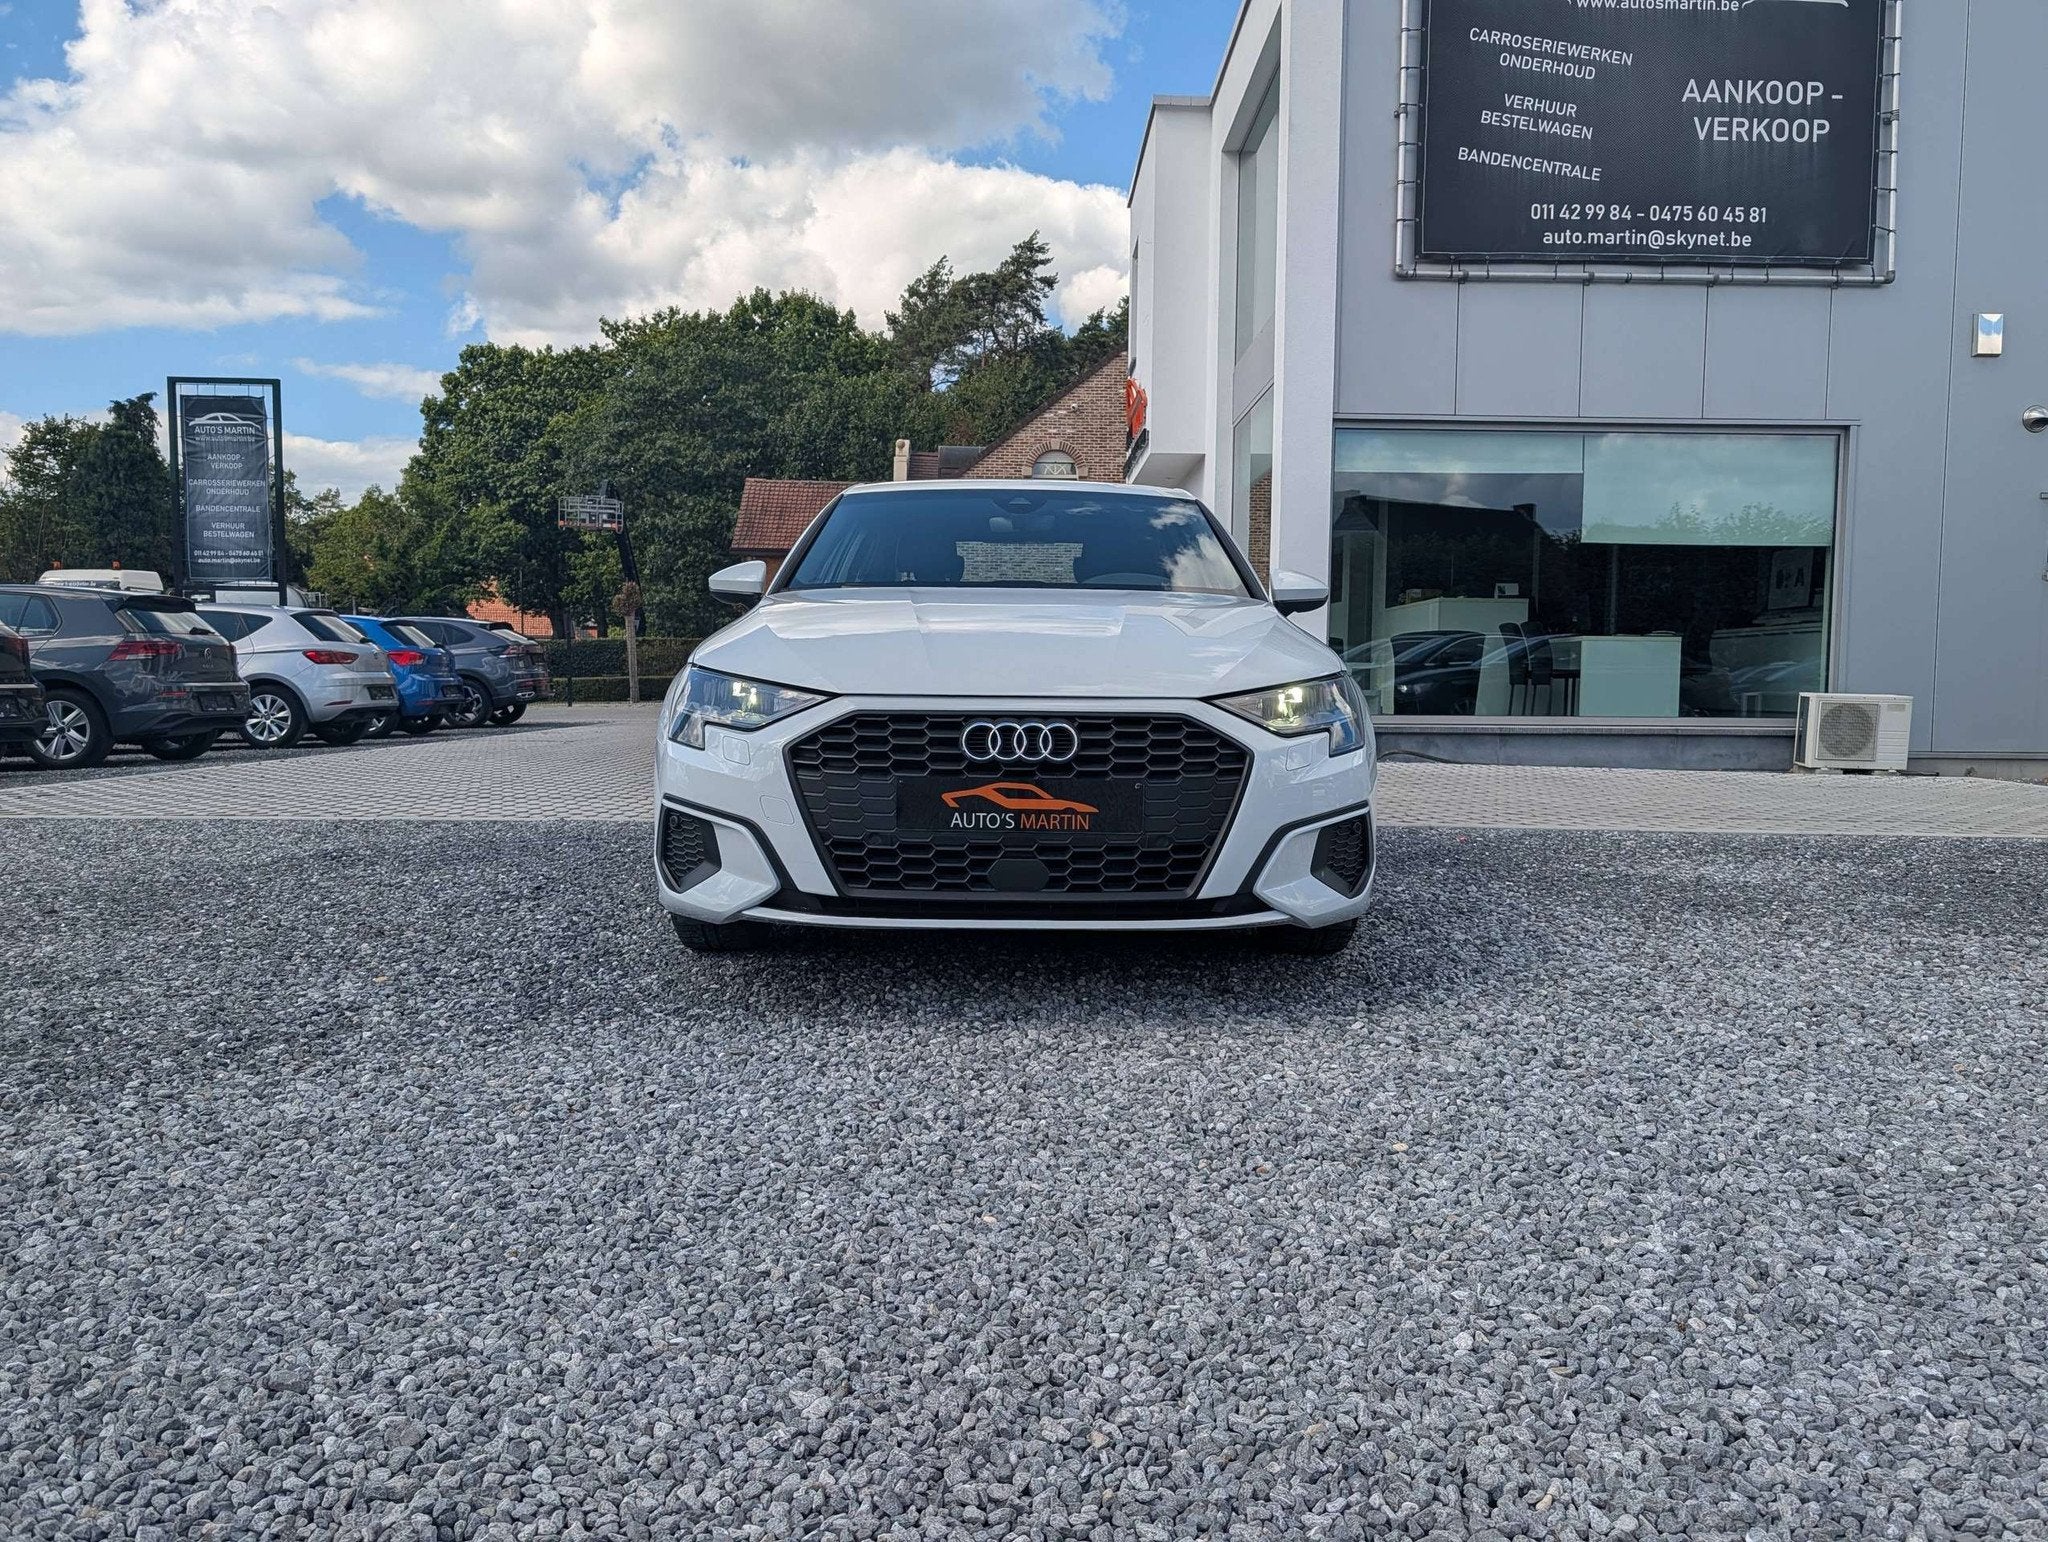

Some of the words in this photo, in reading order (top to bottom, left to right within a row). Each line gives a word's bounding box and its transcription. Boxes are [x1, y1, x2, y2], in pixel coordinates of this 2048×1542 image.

[1469, 27, 1633, 66] CARROSERIEWERKEN
[1499, 52, 1596, 80] ONDERHOUD
[1681, 78, 1824, 105] AANKOOP
[1504, 93, 1578, 117] VERHUUR
[1480, 110, 1593, 140] BESTELWAGEN
[1693, 116, 1831, 143] VERKOOP
[1458, 147, 1602, 181] BANDENCENTRALE
[1530, 203, 1554, 220] 011
[1559, 203, 1580, 220] 42
[1585, 203, 1605, 220] 99
[1609, 204, 1632, 221] 84
[1649, 204, 1693, 222] 0475
[1697, 205, 1719, 222] 60
[1722, 206, 1745, 223] 45
[1749, 206, 1767, 223] 81
[1542, 229, 1752, 250] auto.martin@skynet.be
[194, 426, 223, 434] AUTO'S
[224, 426, 255, 435] MARTIN
[207, 453, 241, 461] AANKOOP
[188, 478, 266, 487] CARROSSERIEWERKEN
[205, 488, 250, 496] ONDERHOUD
[195, 504, 261, 513] BANDENCENTRALE
[203, 530, 255, 538] BESTELWAGEN
[211, 522, 246, 530] VERHUUR
[950, 812, 1015, 829] AUTO'S
[1020, 813, 1090, 830] MARTIN
